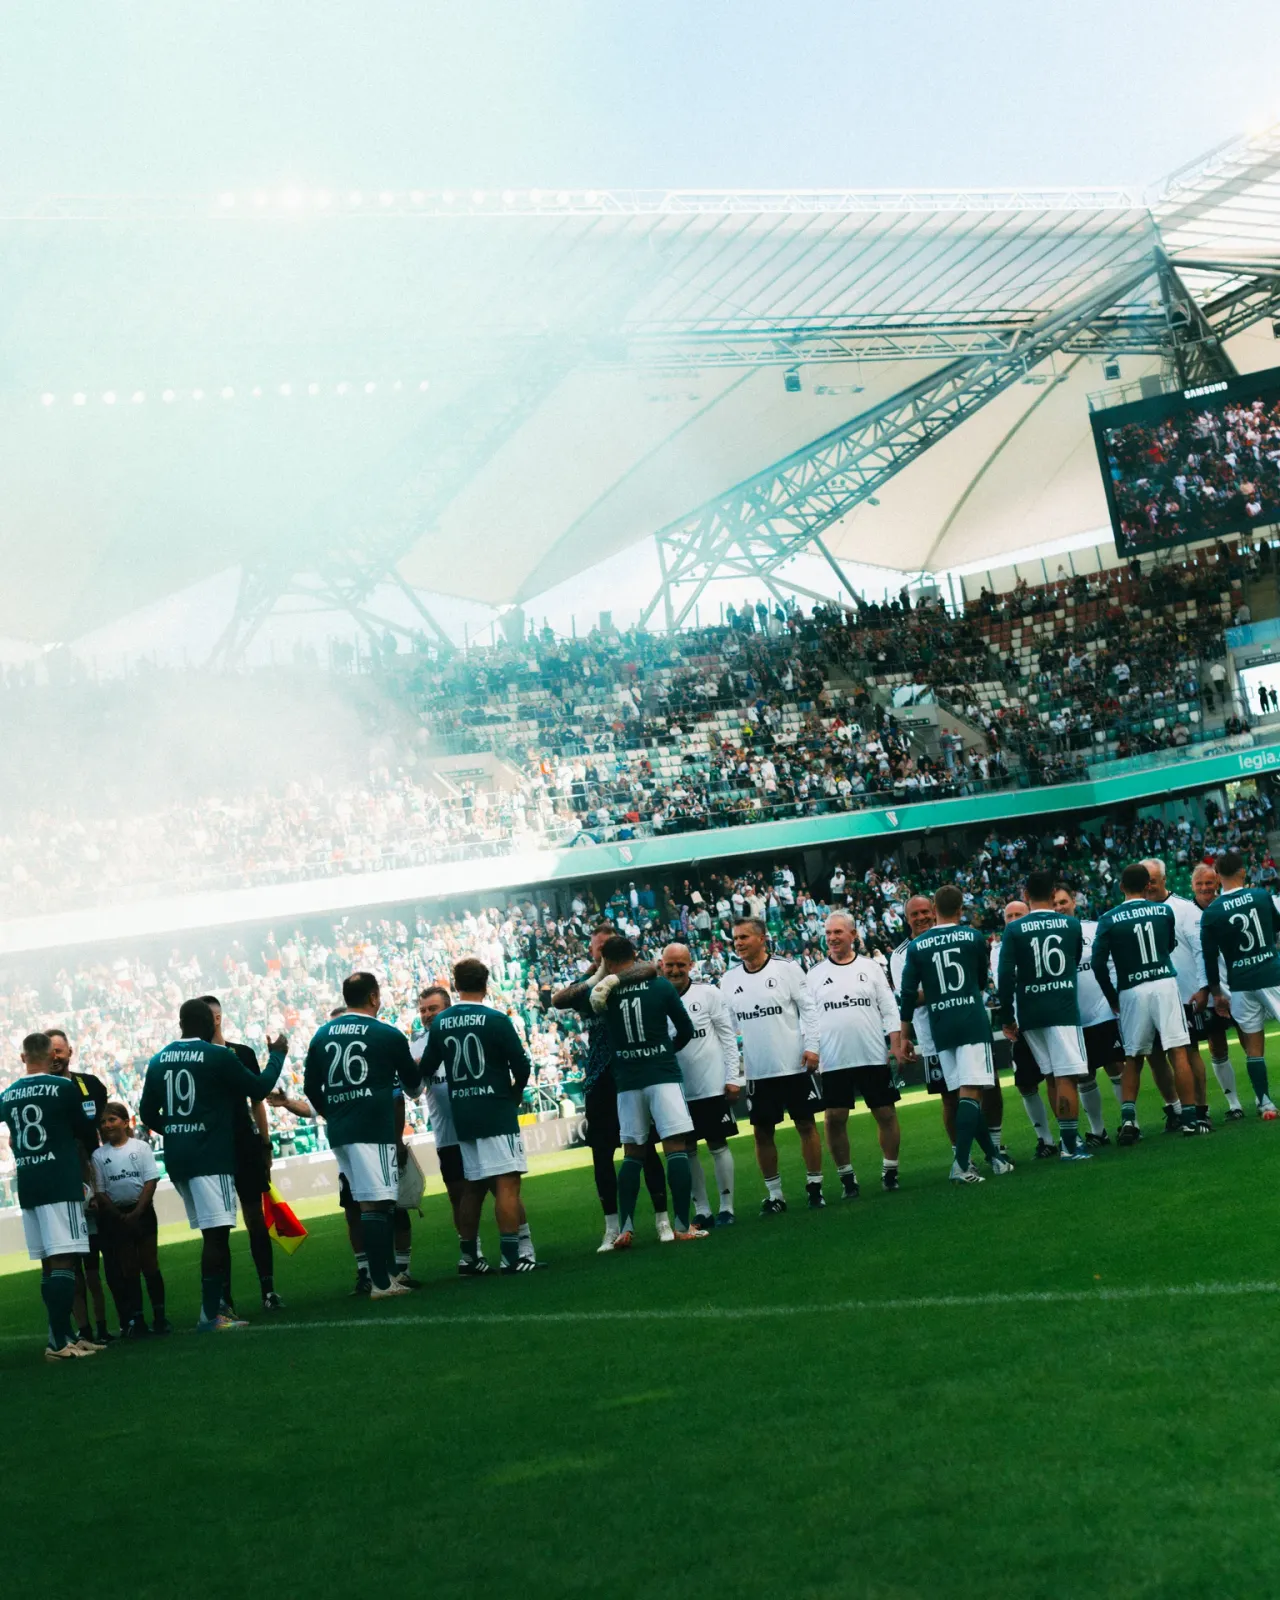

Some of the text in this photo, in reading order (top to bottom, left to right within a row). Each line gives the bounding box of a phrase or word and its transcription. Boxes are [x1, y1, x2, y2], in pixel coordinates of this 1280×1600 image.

[1183, 381, 1228, 400] SAMSUNG
[1238, 751, 1280, 770] legia.
[1223, 893, 1254, 911] RYBUS
[1111, 905, 1168, 923] KIEŁBOWICZ
[1020, 918, 1068, 933] BORYSIUK
[1228, 908, 1266, 952] 31
[916, 930, 974, 951] KOPCZYŃSKI
[1133, 921, 1158, 964] 11
[1030, 934, 1066, 978] 16
[1232, 951, 1274, 968] FORTUNA
[932, 947, 965, 994] 15
[1025, 980, 1074, 993] FORTUNA
[823, 995, 871, 1011] Plus500
[931, 995, 975, 1012] FORTUNA
[619, 997, 646, 1043] 11
[736, 1004, 783, 1022] Plus500
[328, 1023, 369, 1036] KUMBEV
[440, 1014, 486, 1031] PIEKARSKI
[159, 1050, 205, 1063] CHINYAMA
[443, 1032, 486, 1082] 20
[616, 1044, 667, 1060] FORTUNA
[324, 1040, 369, 1087] 26
[163, 1068, 196, 1117] 19
[327, 1087, 373, 1104] FORTUNA
[451, 1085, 495, 1099] FORTUNA
[10, 1103, 47, 1151] 18
[164, 1122, 206, 1134] ORTUNA
[16, 1151, 56, 1167] ORTUNA
